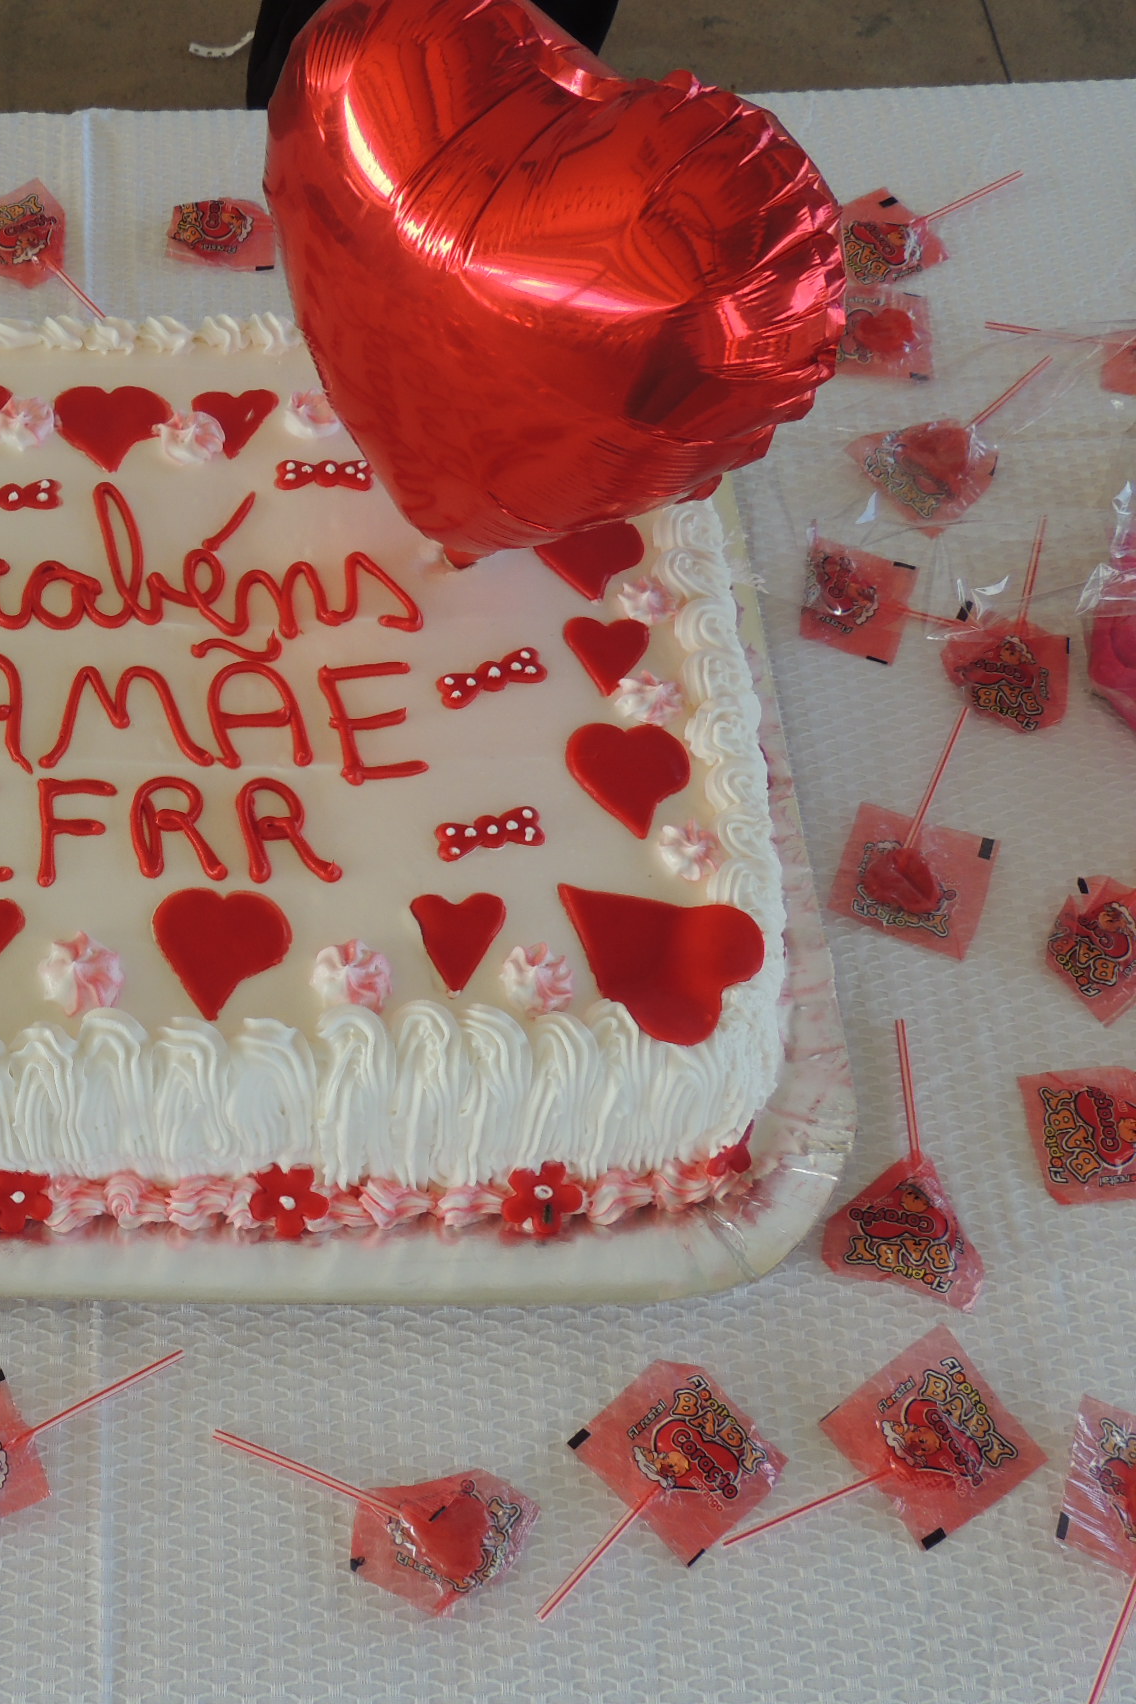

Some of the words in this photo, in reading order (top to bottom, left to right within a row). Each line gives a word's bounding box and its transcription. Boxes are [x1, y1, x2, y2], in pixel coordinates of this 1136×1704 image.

[970, 684, 1043, 715] BAB
[1038, 1086, 1105, 1185] BABY
[1044, 1126, 1070, 1184] Flopito
[849, 1204, 937, 1236] Coração
[843, 1235, 958, 1275] BABY
[938, 1355, 989, 1417] Flopito
[626, 1398, 668, 1441] Florestal
[669, 1386, 769, 1476] BABY
[918, 1367, 1020, 1468] BABY
[671, 1427, 739, 1500] Coração
